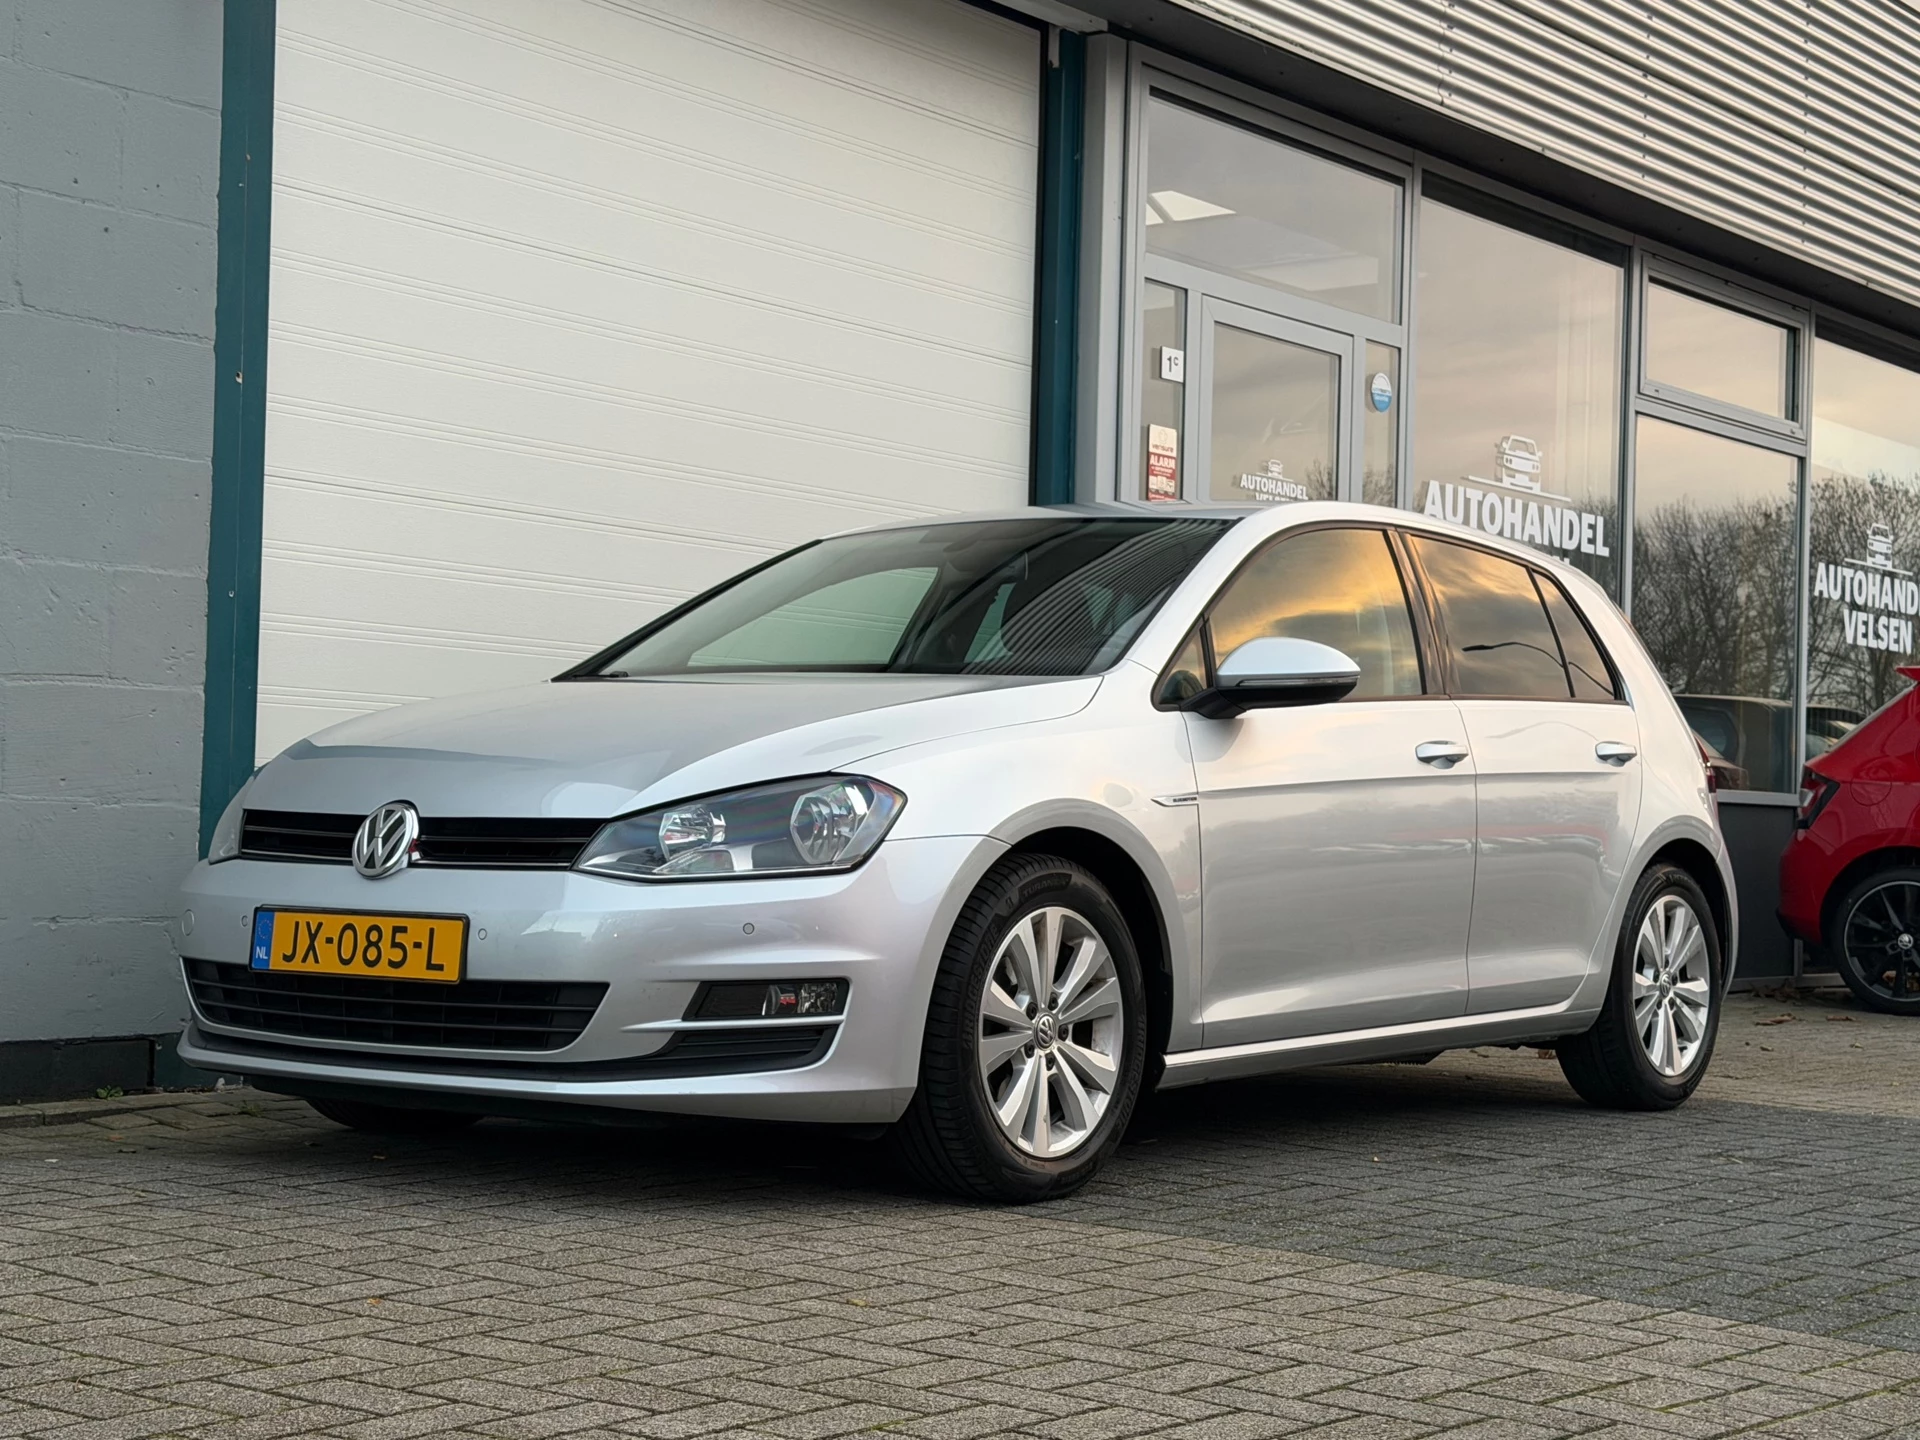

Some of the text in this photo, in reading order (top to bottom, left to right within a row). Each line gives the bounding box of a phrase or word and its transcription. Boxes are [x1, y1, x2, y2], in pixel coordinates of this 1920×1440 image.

[1149, 454, 1176, 470] ALARM
[1240, 473, 1308, 500] AUTOHANDEL
[1424, 480, 1610, 557] AUTOHANDEL
[1814, 562, 1920, 616] AUTOHAND
[1843, 608, 1912, 656] VELSEN
[255, 946, 268, 959] NL
[282, 920, 444, 972] JX-085-L
